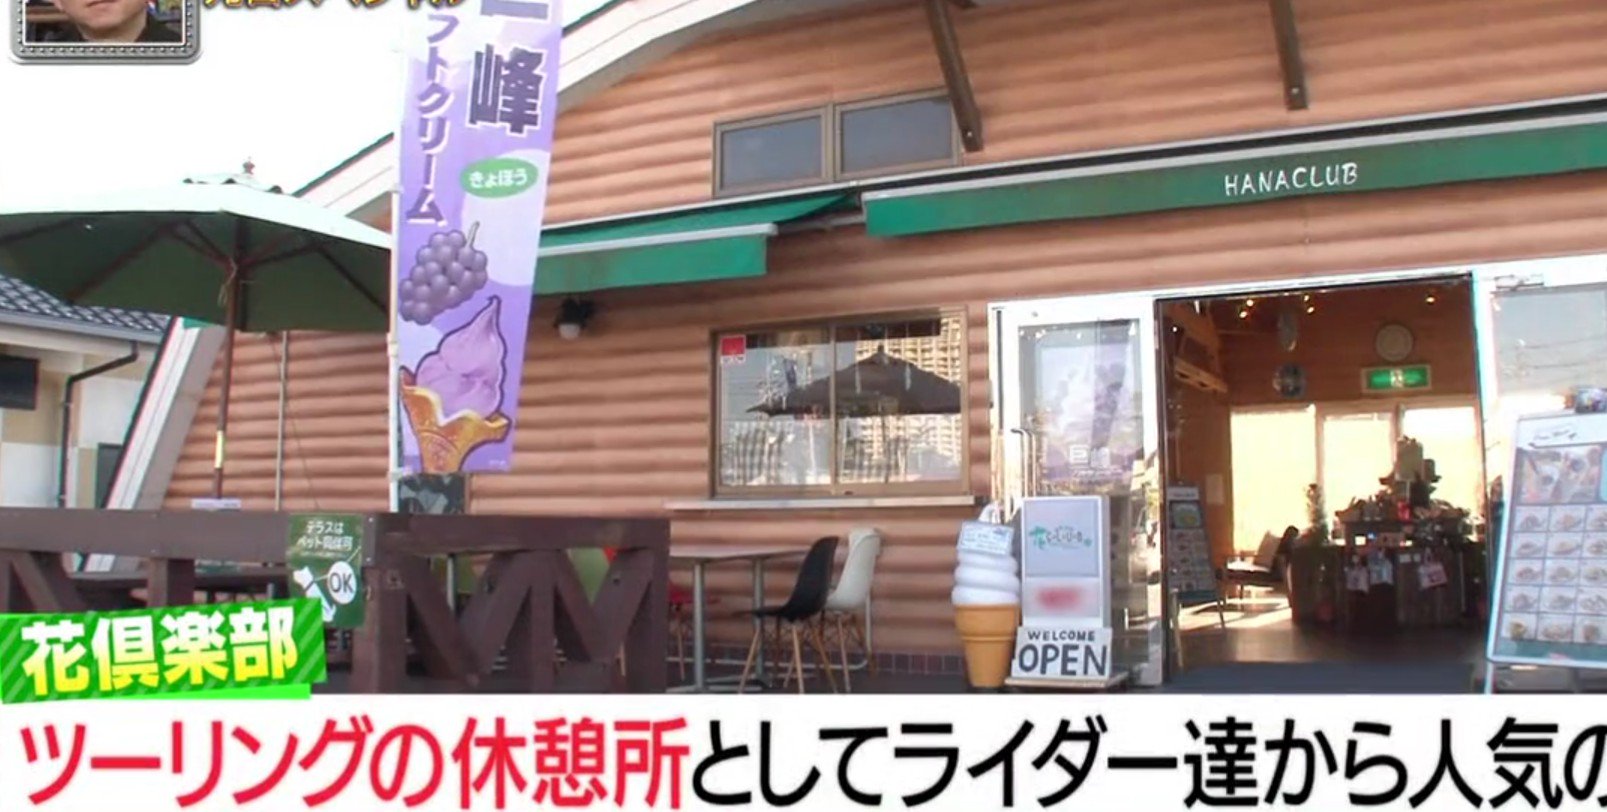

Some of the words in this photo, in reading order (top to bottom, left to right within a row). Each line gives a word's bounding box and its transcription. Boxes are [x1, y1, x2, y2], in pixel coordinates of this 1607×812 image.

[469, 167, 528, 189] きょほう
[1224, 162, 1358, 196] HANACLUB
[306, 520, 345, 535] テラスは
[329, 572, 354, 593] OK
[1027, 630, 1096, 642] WELCOME
[1018, 643, 1108, 677] OPEN
